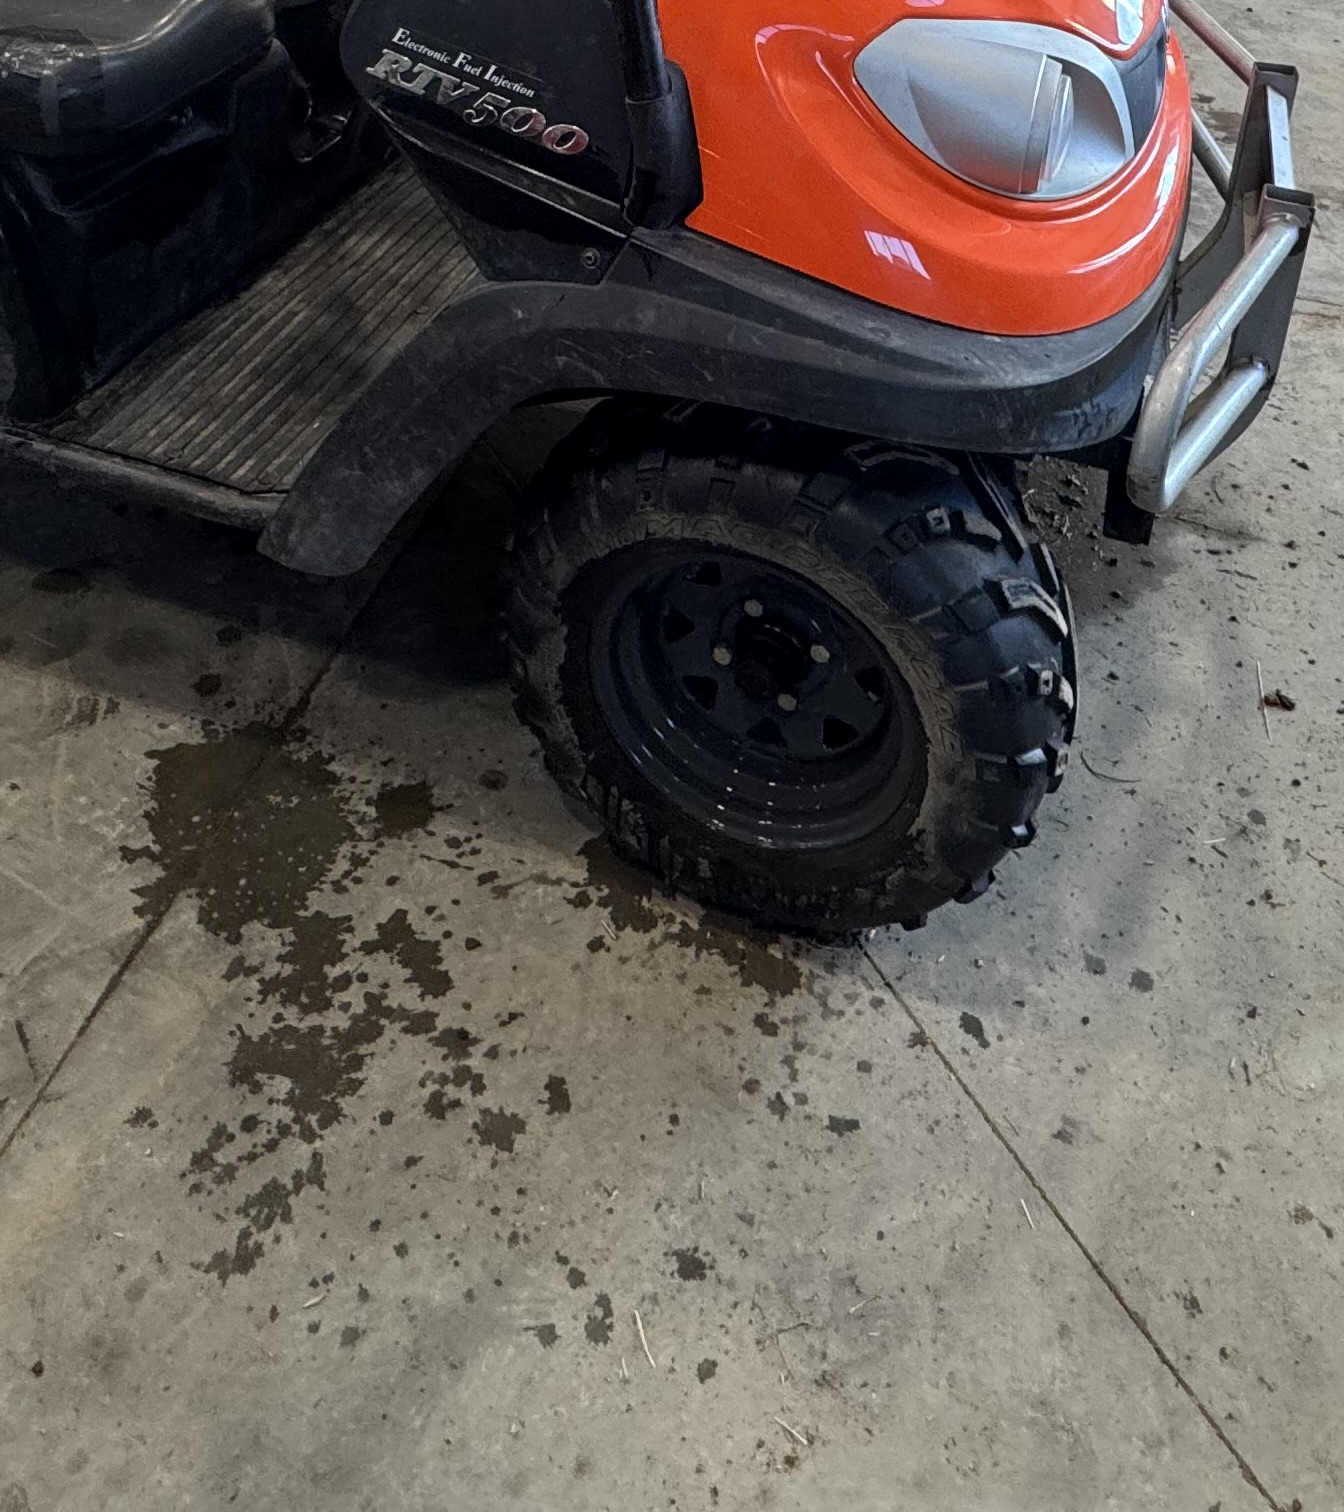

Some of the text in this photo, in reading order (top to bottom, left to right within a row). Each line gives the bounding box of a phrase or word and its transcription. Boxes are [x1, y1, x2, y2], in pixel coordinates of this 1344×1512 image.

[392, 27, 536, 99] Electronic Fuel Injection
